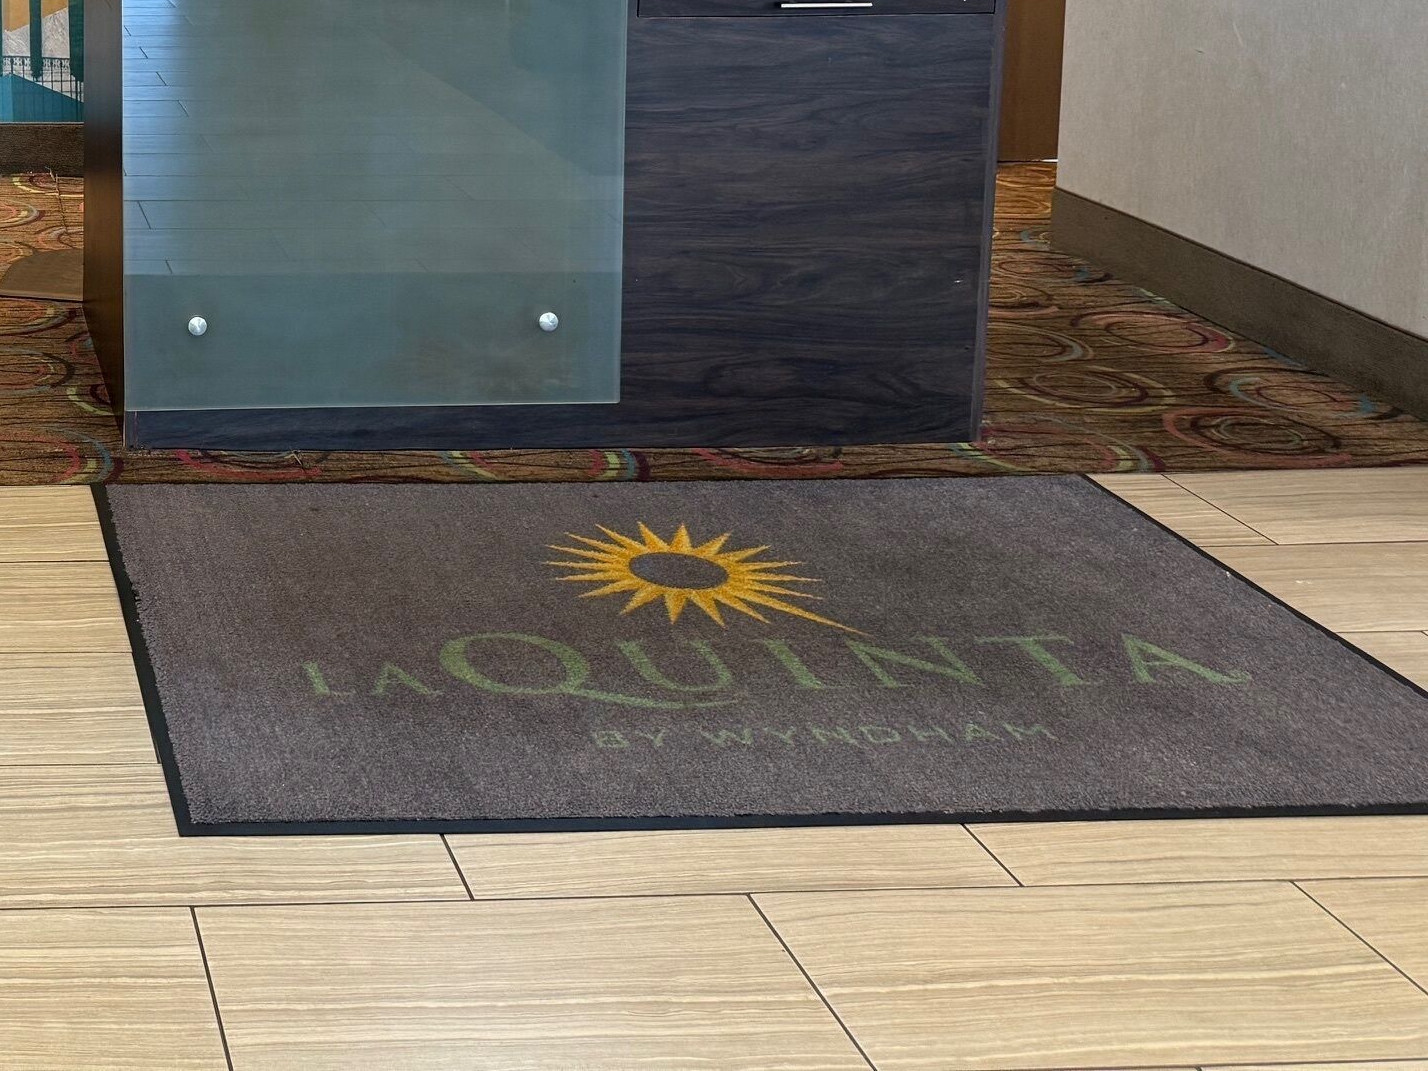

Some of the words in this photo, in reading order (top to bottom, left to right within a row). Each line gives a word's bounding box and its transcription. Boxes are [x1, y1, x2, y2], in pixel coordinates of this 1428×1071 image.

[302, 660, 442, 697] LA
[438, 631, 1255, 710] QUINTA
[590, 728, 666, 749] BY
[700, 723, 1058, 748] WYNDHAM
